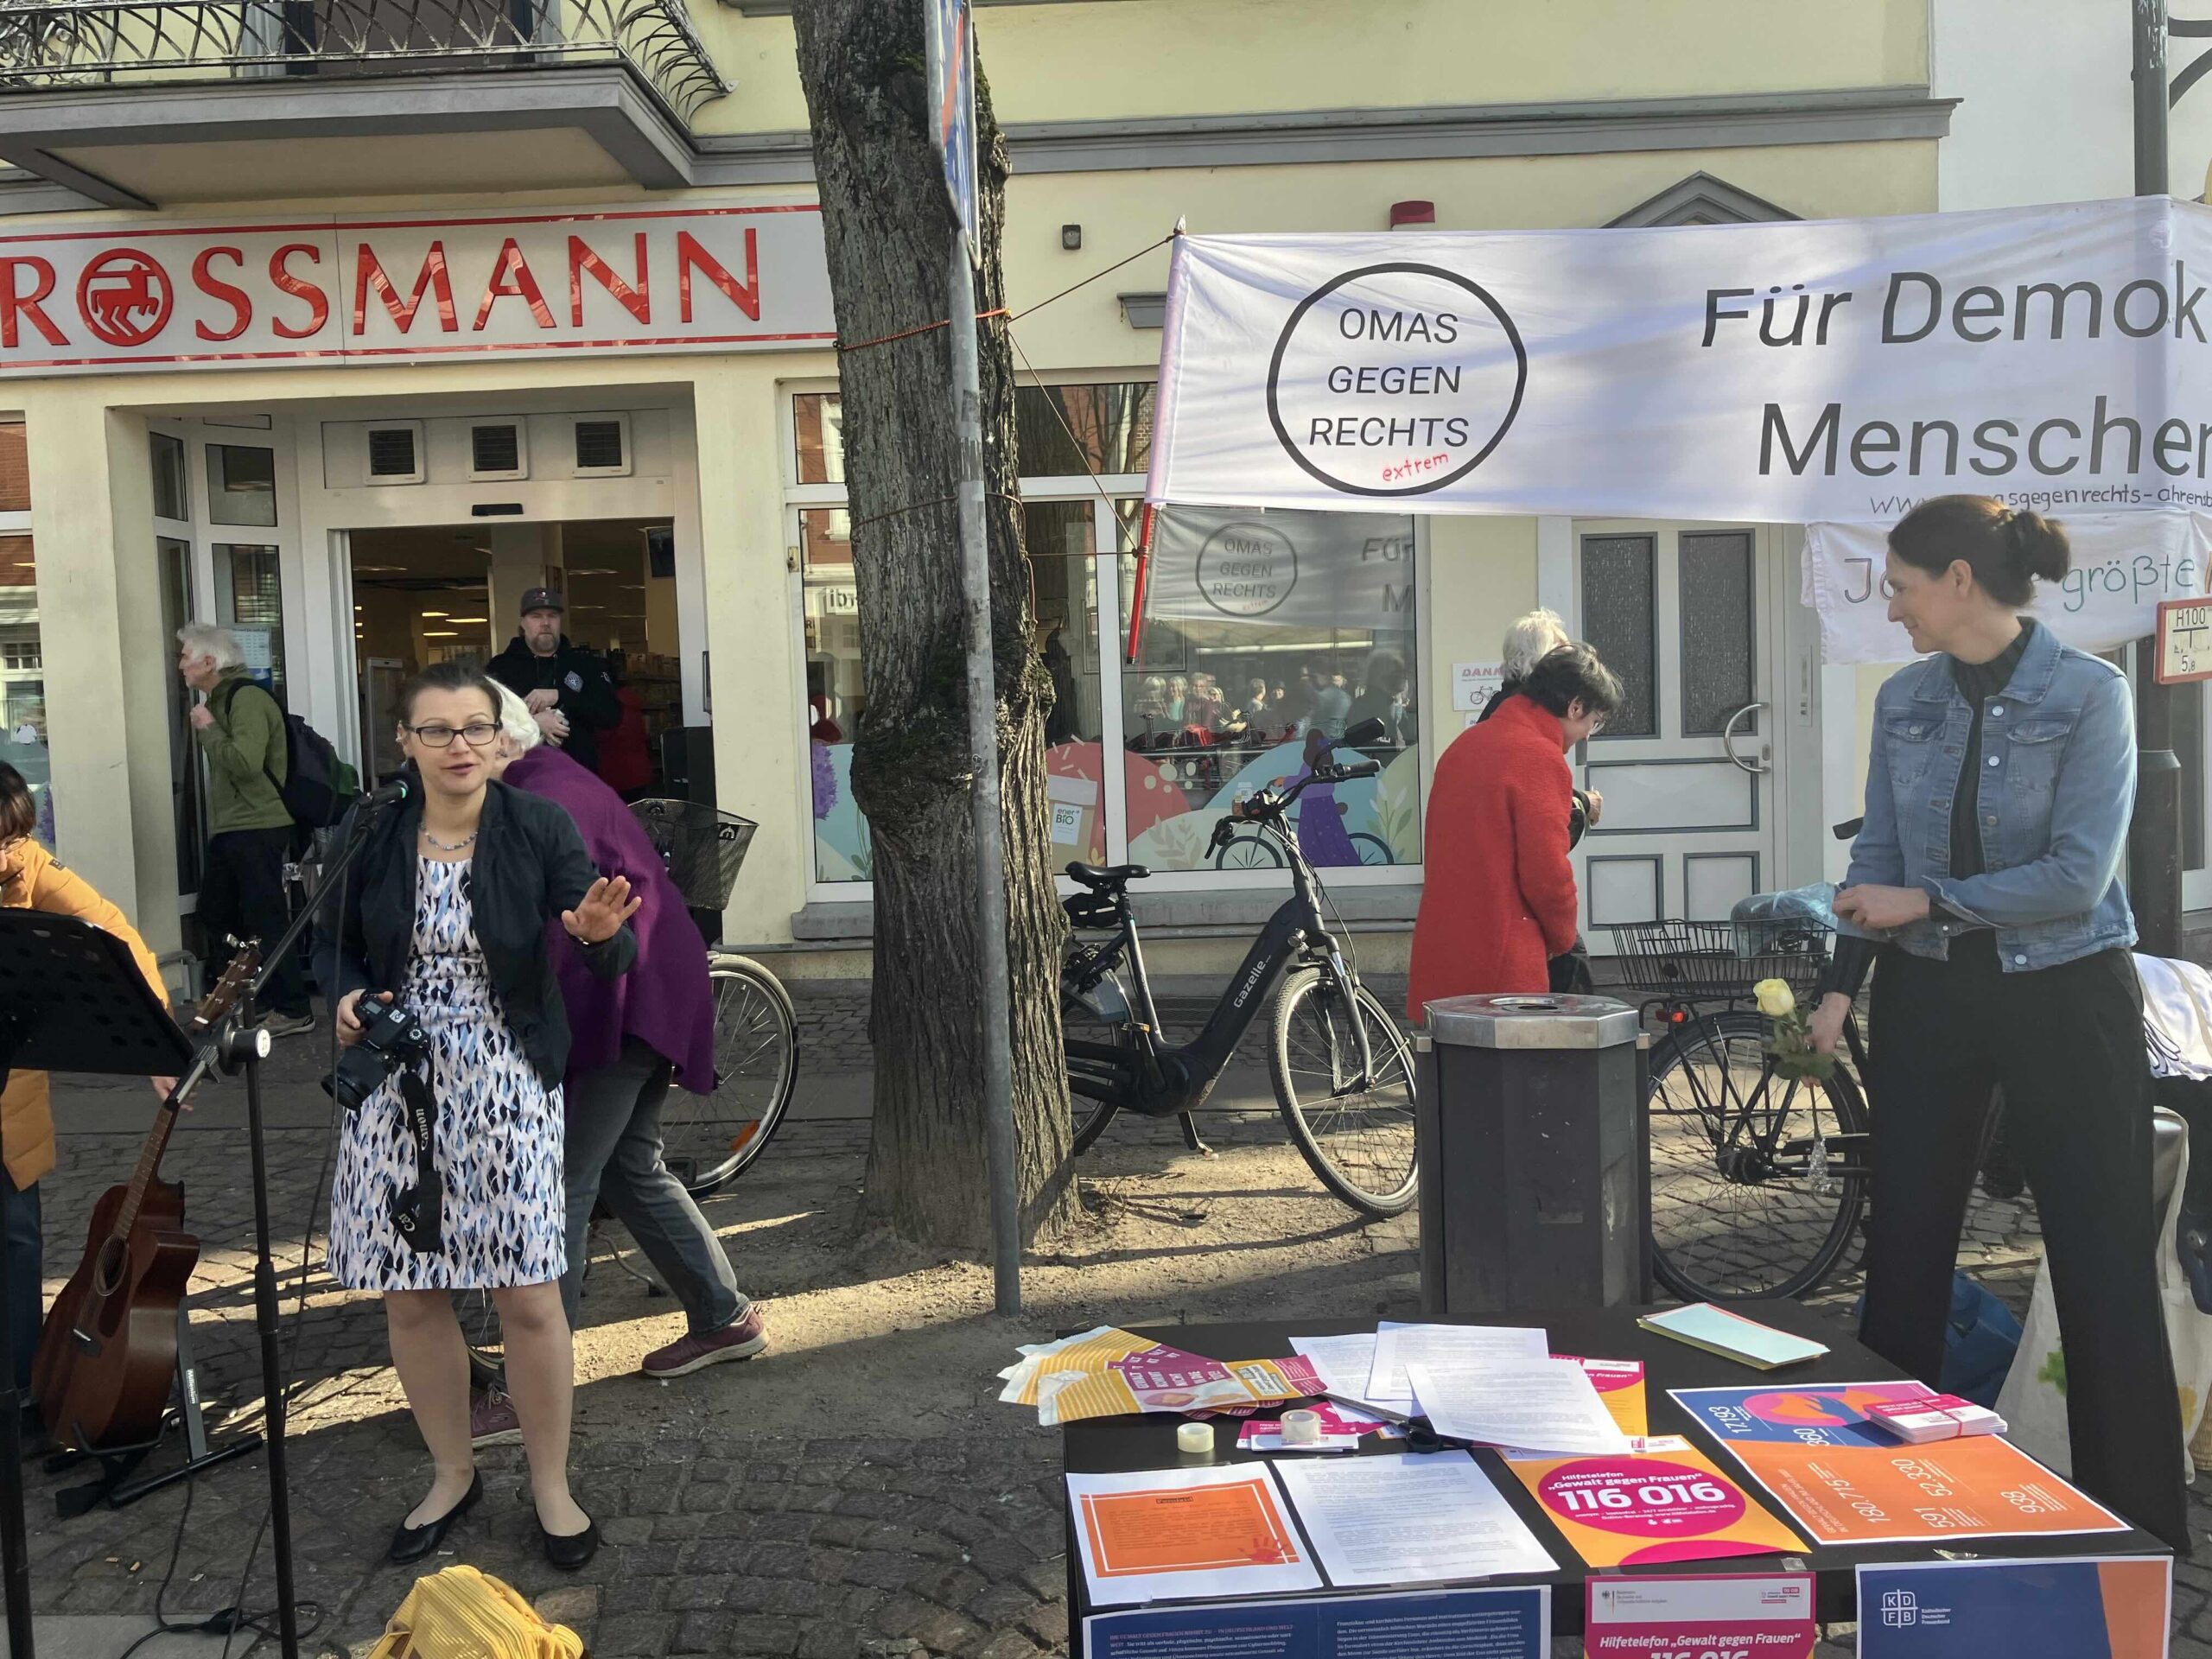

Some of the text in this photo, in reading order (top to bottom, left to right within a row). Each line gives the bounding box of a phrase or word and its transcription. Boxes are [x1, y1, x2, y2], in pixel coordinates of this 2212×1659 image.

[0, 227, 760, 346] ROSSMANN
[1339, 308, 1459, 344] OMAS
[1701, 283, 1853, 347] Für
[1327, 365, 1461, 395] GEGEN
[1308, 416, 1470, 448] RECHTS
[1382, 452, 1449, 482] extrem
[1224, 537, 1273, 556] OMAS
[1219, 562, 1273, 578] GEGEN
[1211, 582, 1277, 599] RECHTS
[2176, 607, 2206, 626] H100
[1233, 960, 1267, 1008] Gazelle
[416, 1108, 429, 1152] Canon
[1708, 1406, 1751, 1433] 17.193
[1794, 1427, 1830, 1447] 360
[1548, 1472, 1702, 1491] „Gewalt gegen Frauen“
[1561, 1471, 1624, 1480] Hilfetelefon
[1891, 1459, 1953, 1497] 52.330
[1557, 1482, 1726, 1510] 116 016
[1824, 1479, 1891, 1522] 180.715
[2000, 1491, 2045, 1514] 938
[1912, 1507, 1956, 1529] 591
[1599, 1633, 1802, 1649] Hilfetelefon „Gewalt gegen Frauen“
